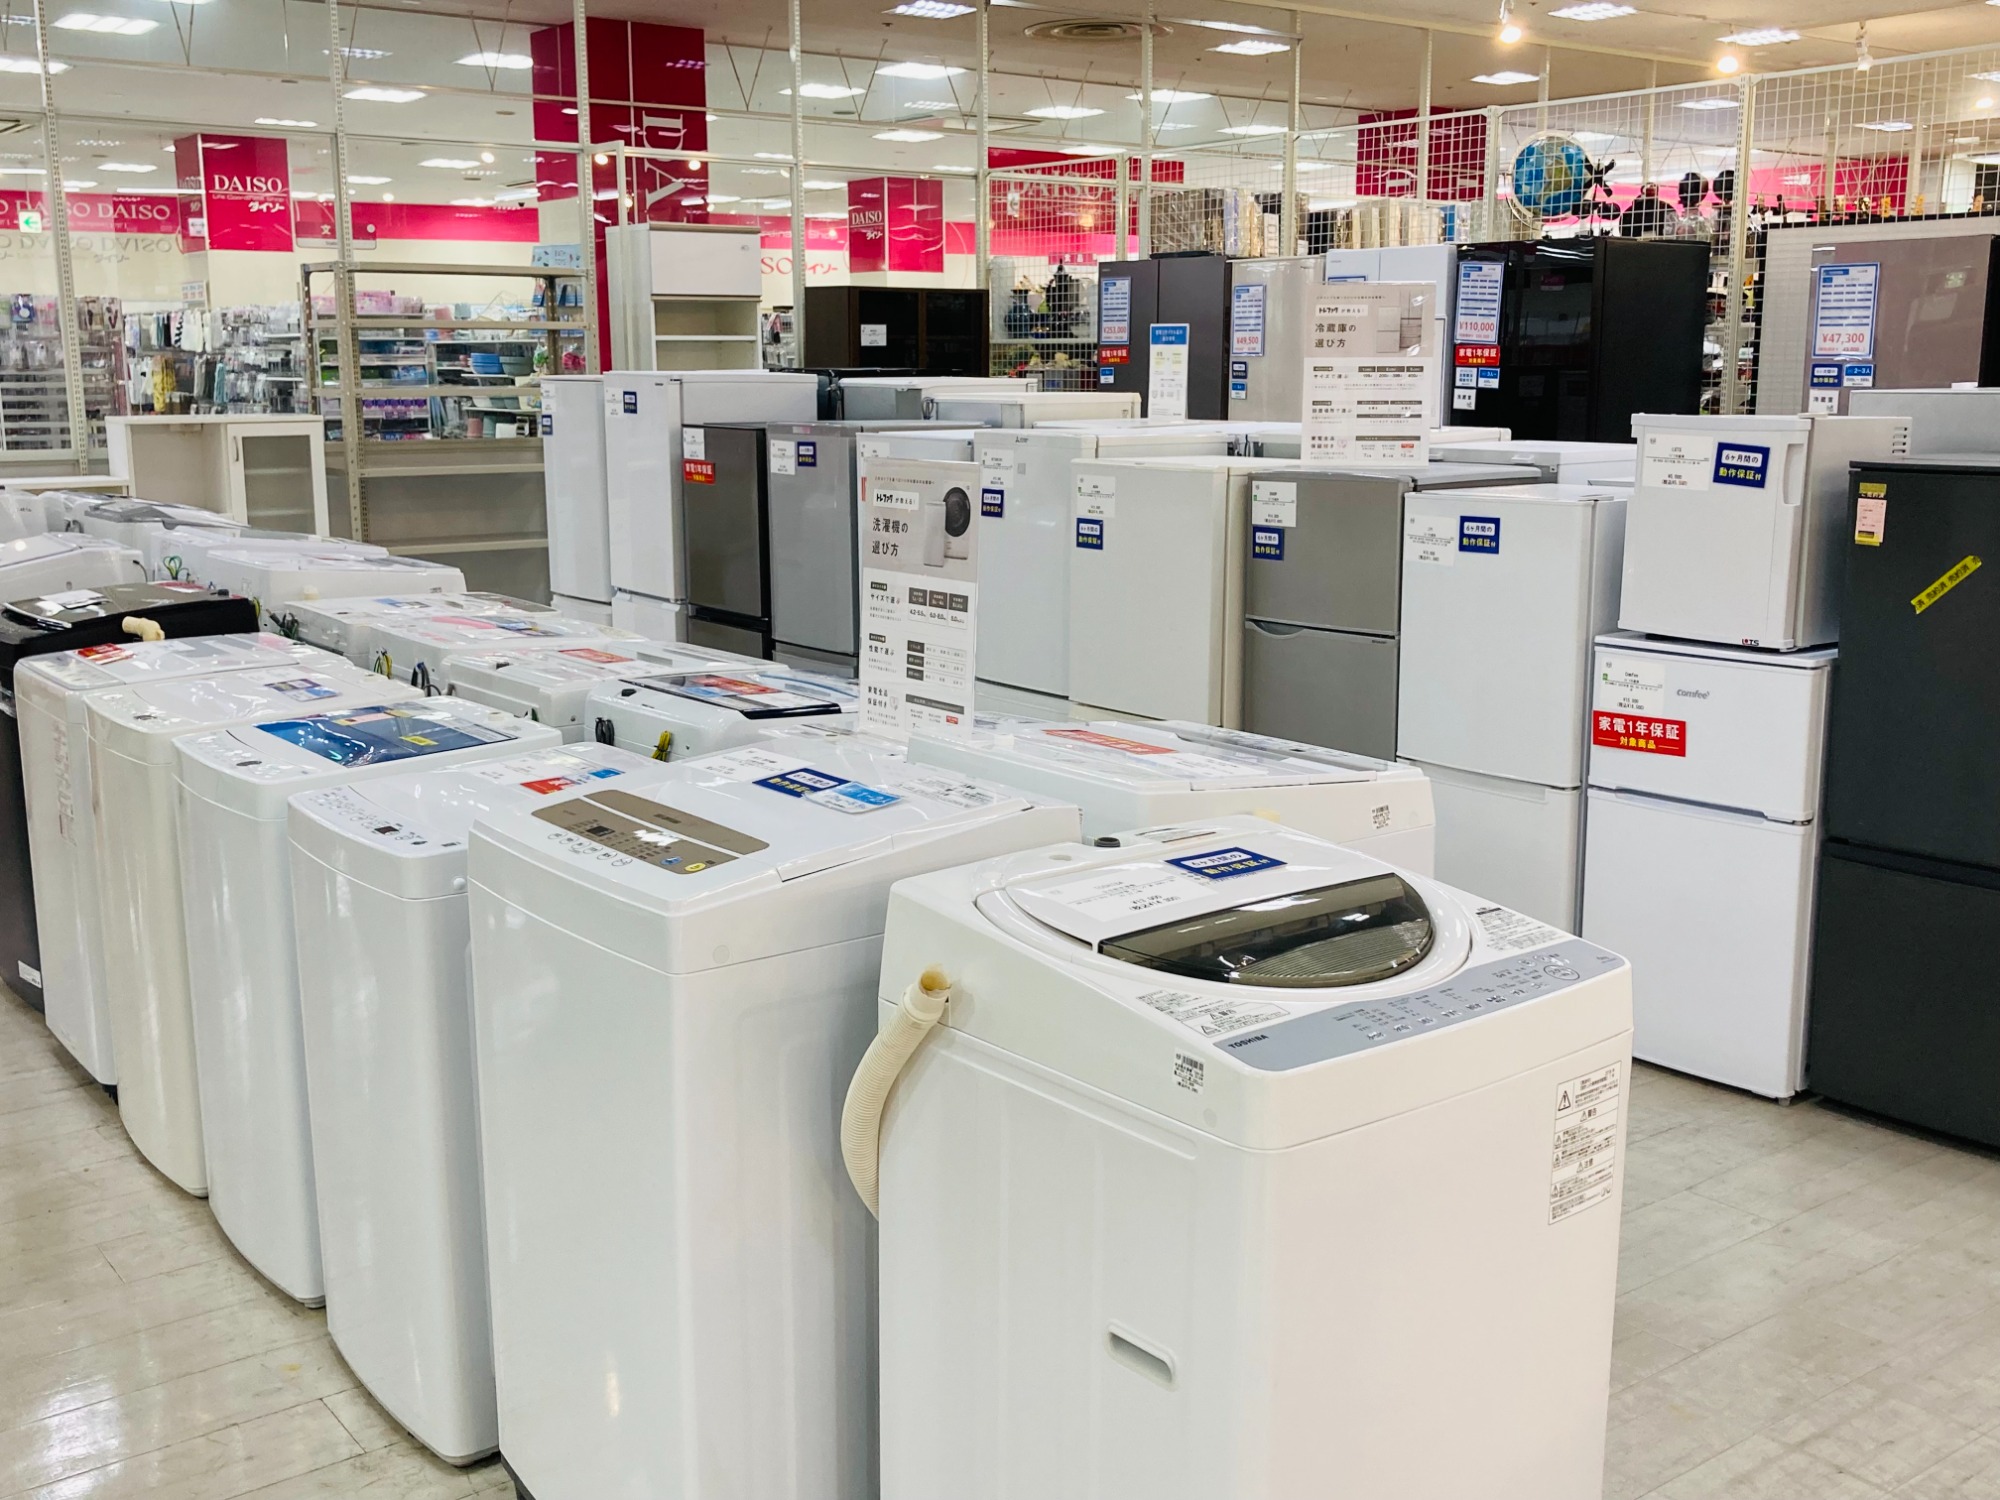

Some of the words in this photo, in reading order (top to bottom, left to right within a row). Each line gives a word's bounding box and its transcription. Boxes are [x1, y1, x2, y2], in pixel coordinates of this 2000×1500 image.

[213, 174, 283, 194] DAISO
[97, 202, 171, 221] DAISO
[248, 200, 285, 213] ダイソー
[851, 210, 882, 226] DAISO
[1314, 322, 1357, 333] 冷蔵庫の
[1314, 338, 1346, 348] 選び方
[1822, 332, 1865, 344] ¥47,300
[1458, 348, 1497, 358] 家電1年保証
[1718, 466, 1762, 481] 動作保証付
[872, 516, 909, 534] 洗濯機の
[871, 540, 899, 557] 選び方
[1598, 715, 1681, 741] 家電1年保証
[1619, 736, 1657, 750] 対象商品
[1202, 858, 1271, 875] 動作保証付
[1228, 1033, 1269, 1050] TOSHIBA
